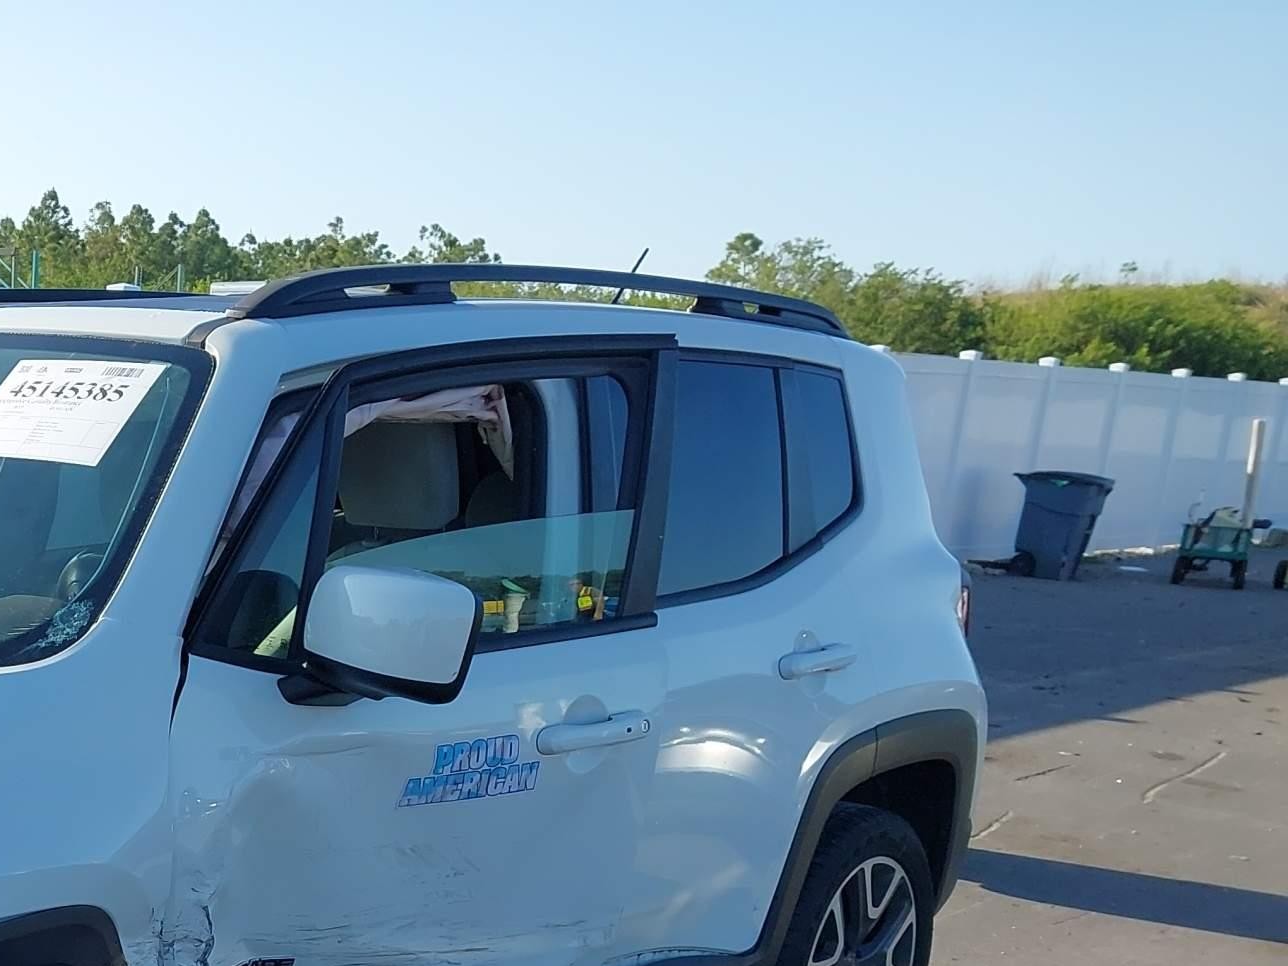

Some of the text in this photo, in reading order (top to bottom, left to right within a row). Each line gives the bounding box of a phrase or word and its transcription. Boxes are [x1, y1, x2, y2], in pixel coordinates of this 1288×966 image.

[10, 380, 130, 402] 45145385
[432, 734, 520, 775] PROUD
[398, 761, 540, 807] AMERICAN
